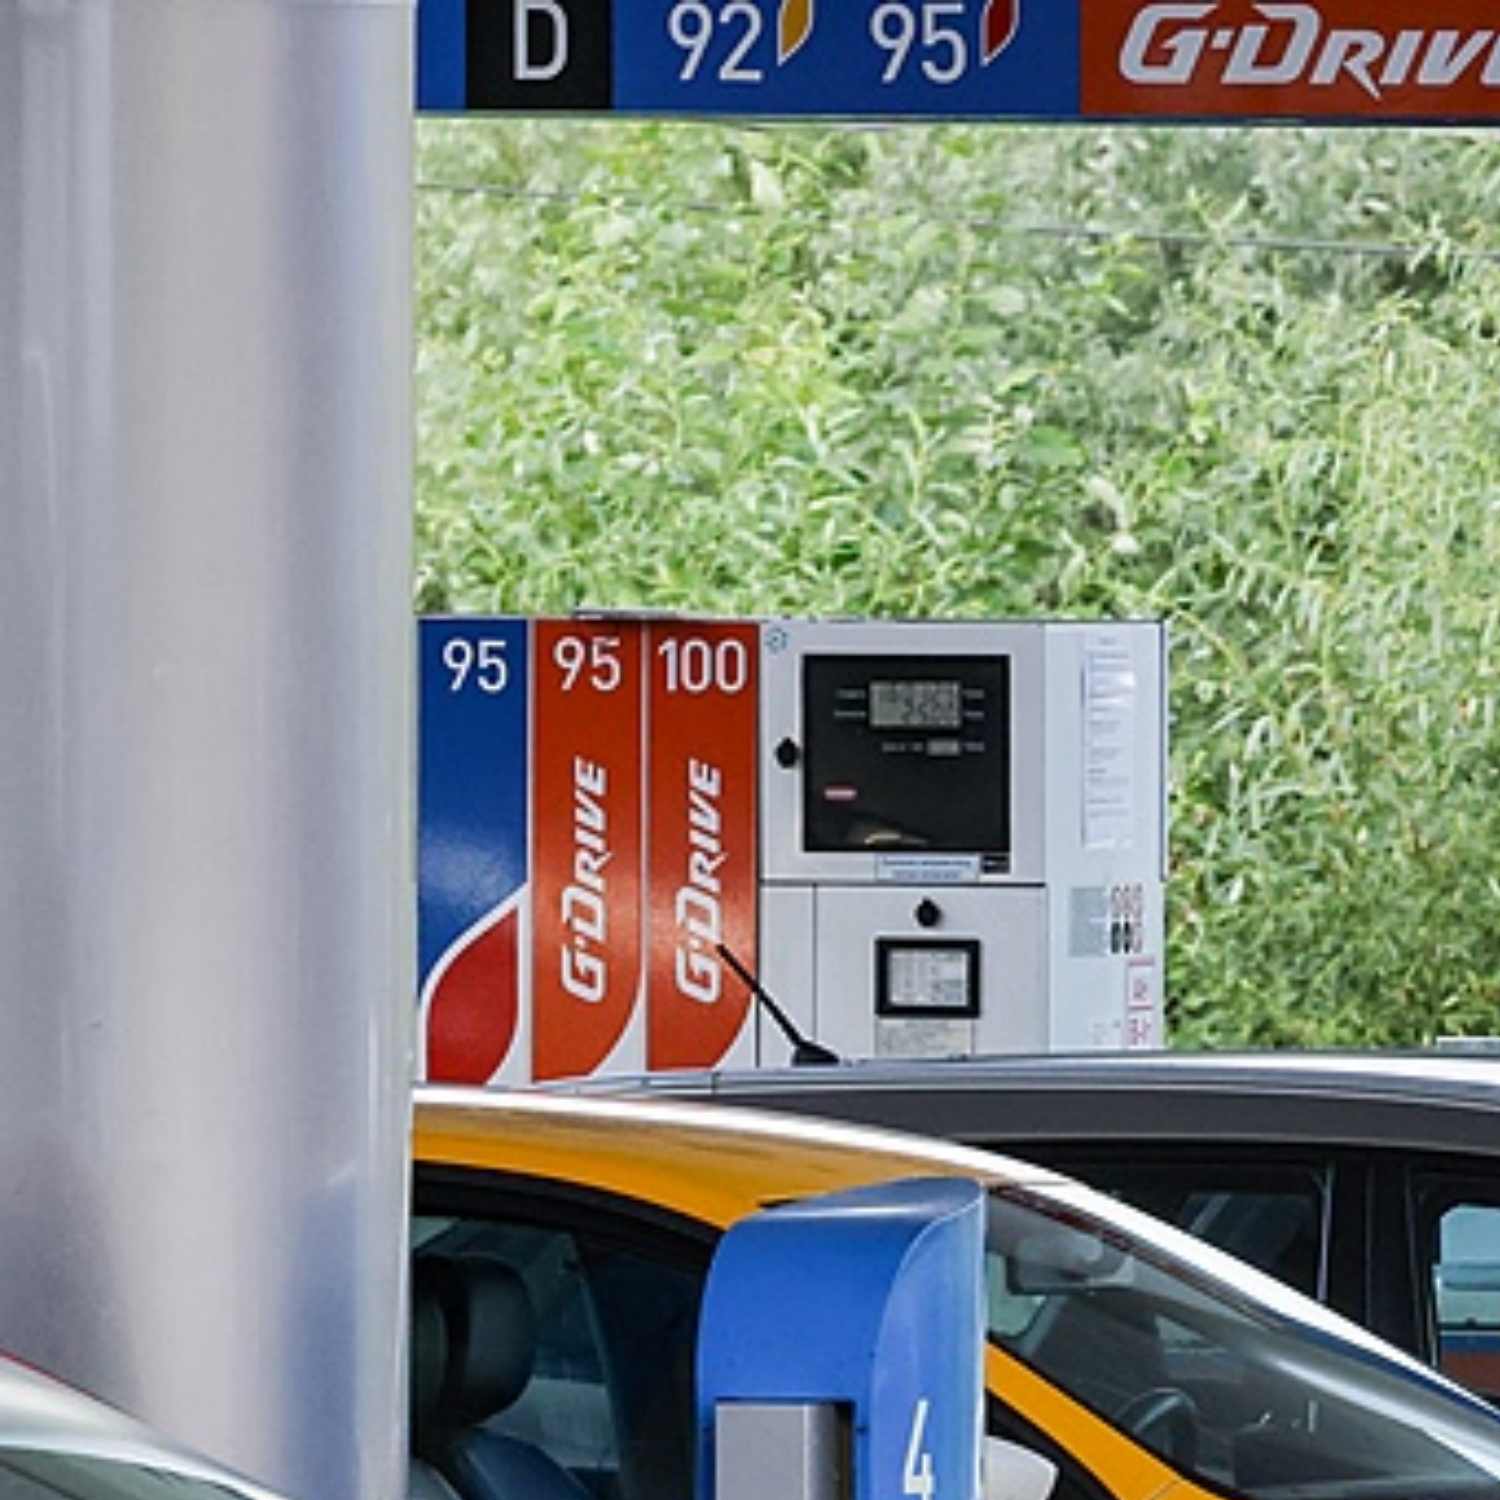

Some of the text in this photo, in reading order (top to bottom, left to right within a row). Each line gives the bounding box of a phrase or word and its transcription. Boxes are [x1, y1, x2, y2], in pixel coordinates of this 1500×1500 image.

[513, 0, 967, 82] D 92 95
[442, 638, 508, 694] 95
[553, 636, 622, 692] 95
[658, 639, 748, 694] 100
